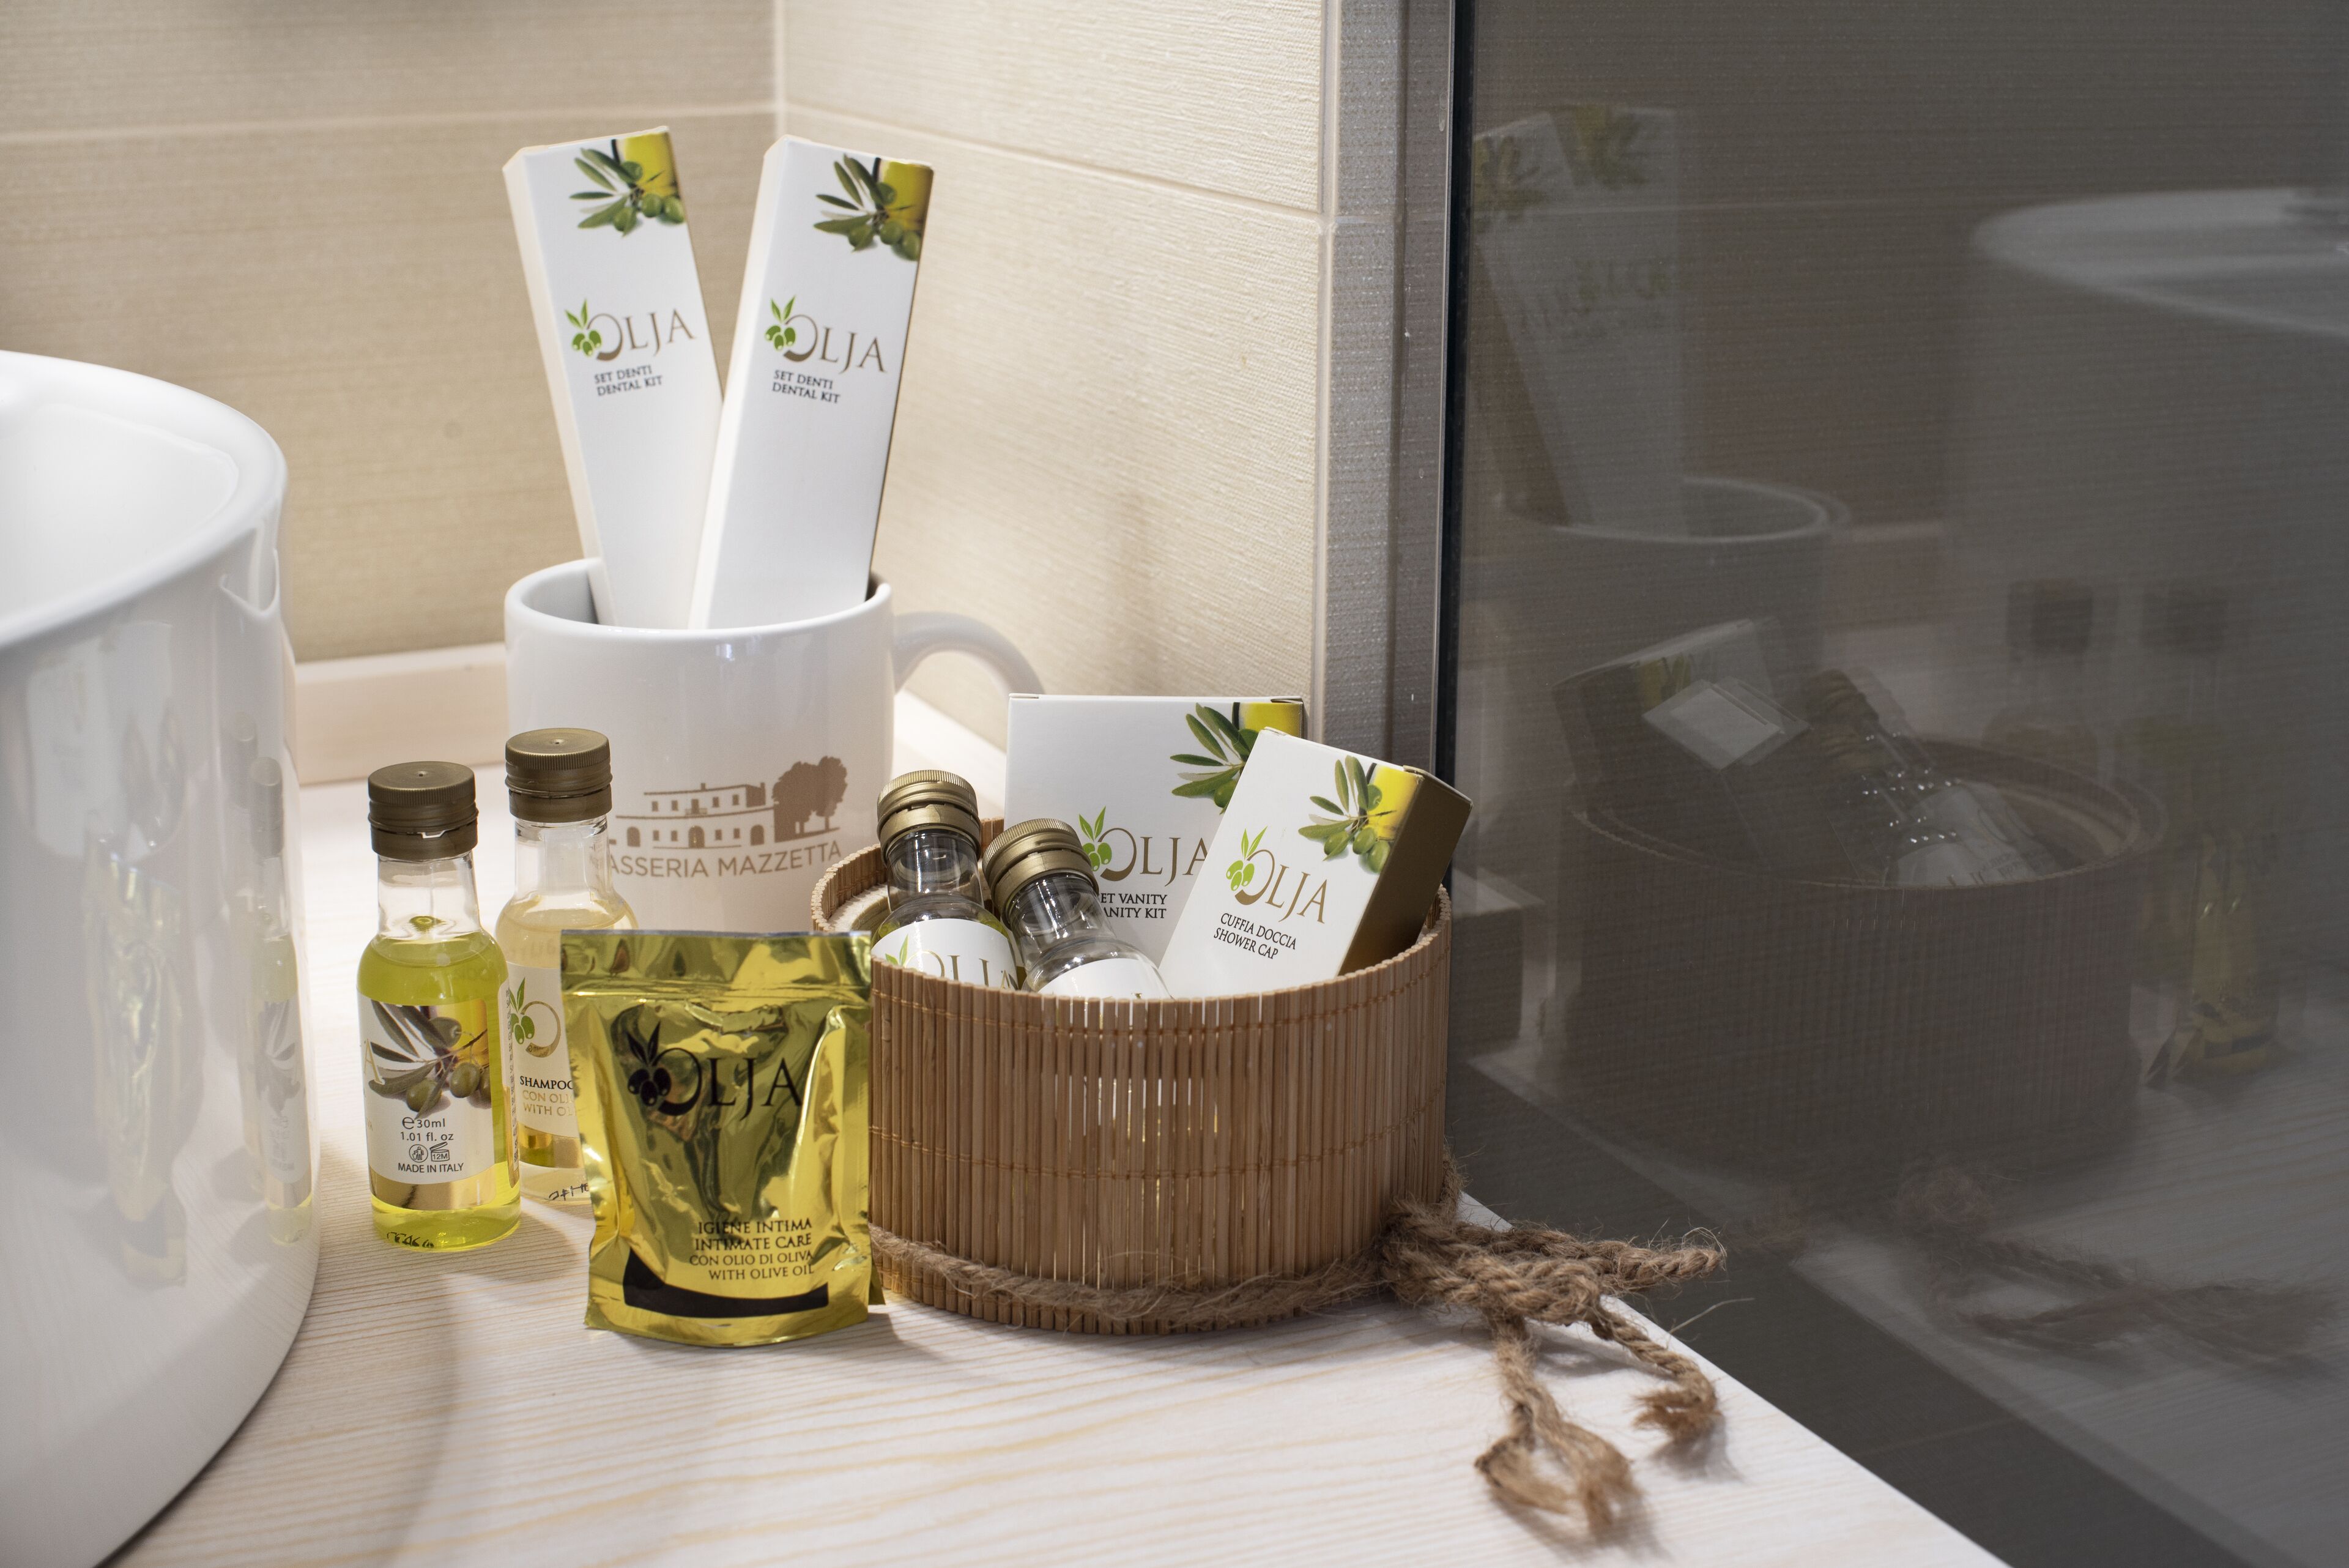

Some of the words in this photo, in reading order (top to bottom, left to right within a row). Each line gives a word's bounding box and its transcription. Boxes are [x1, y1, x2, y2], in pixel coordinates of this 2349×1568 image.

[586, 309, 696, 362] OLJA
[783, 314, 888, 374] OLJA
[593, 372, 614, 384] SET
[616, 365, 653, 380] DENTI
[774, 370, 795, 382] SET
[796, 374, 834, 390] DENTI
[597, 379, 642, 396] DENTAL
[644, 375, 662, 388] KIT
[772, 382, 818, 400] DENTAL
[820, 392, 841, 404] KIT
[610, 855, 709, 877] ASSERIA
[719, 841, 842, 877] MAZZETTA
[1097, 827, 1209, 887] OLJA
[1234, 849, 1326, 924] OLJA
[1100, 893, 1115, 904] ET
[1118, 893, 1168, 905] VANITY
[1104, 907, 1142, 918] NITY
[1145, 908, 1167, 919] KIT
[1220, 913, 1254, 935] CUFFIA
[1256, 925, 1297, 950] DOCCIA
[1214, 927, 1256, 953] SHOWER
[1258, 943, 1278, 959] CAP
[651, 1048, 804, 1121] OLJA
[522, 1090, 546, 1102] CON
[523, 1102, 552, 1115] WITH
[401, 1132, 421, 1142] 1.01
[426, 1132, 437, 1142] fl.
[398, 1163, 425, 1173] MADE
[427, 1164, 438, 1173] IN
[439, 1163, 464, 1172] ITALY
[699, 1221, 751, 1235] IGIENE
[756, 1217, 812, 1234] INTIMA
[695, 1237, 770, 1251] INTIMATE
[775, 1233, 812, 1249] CARE
[689, 1255, 719, 1266] CON
[722, 1254, 755, 1265] OLIO
[759, 1254, 773, 1265] DI
[777, 1250, 814, 1263] OLIVA
[708, 1268, 745, 1280] WITH
[750, 1266, 789, 1279] OLIVE
[793, 1263, 815, 1276] OIL
